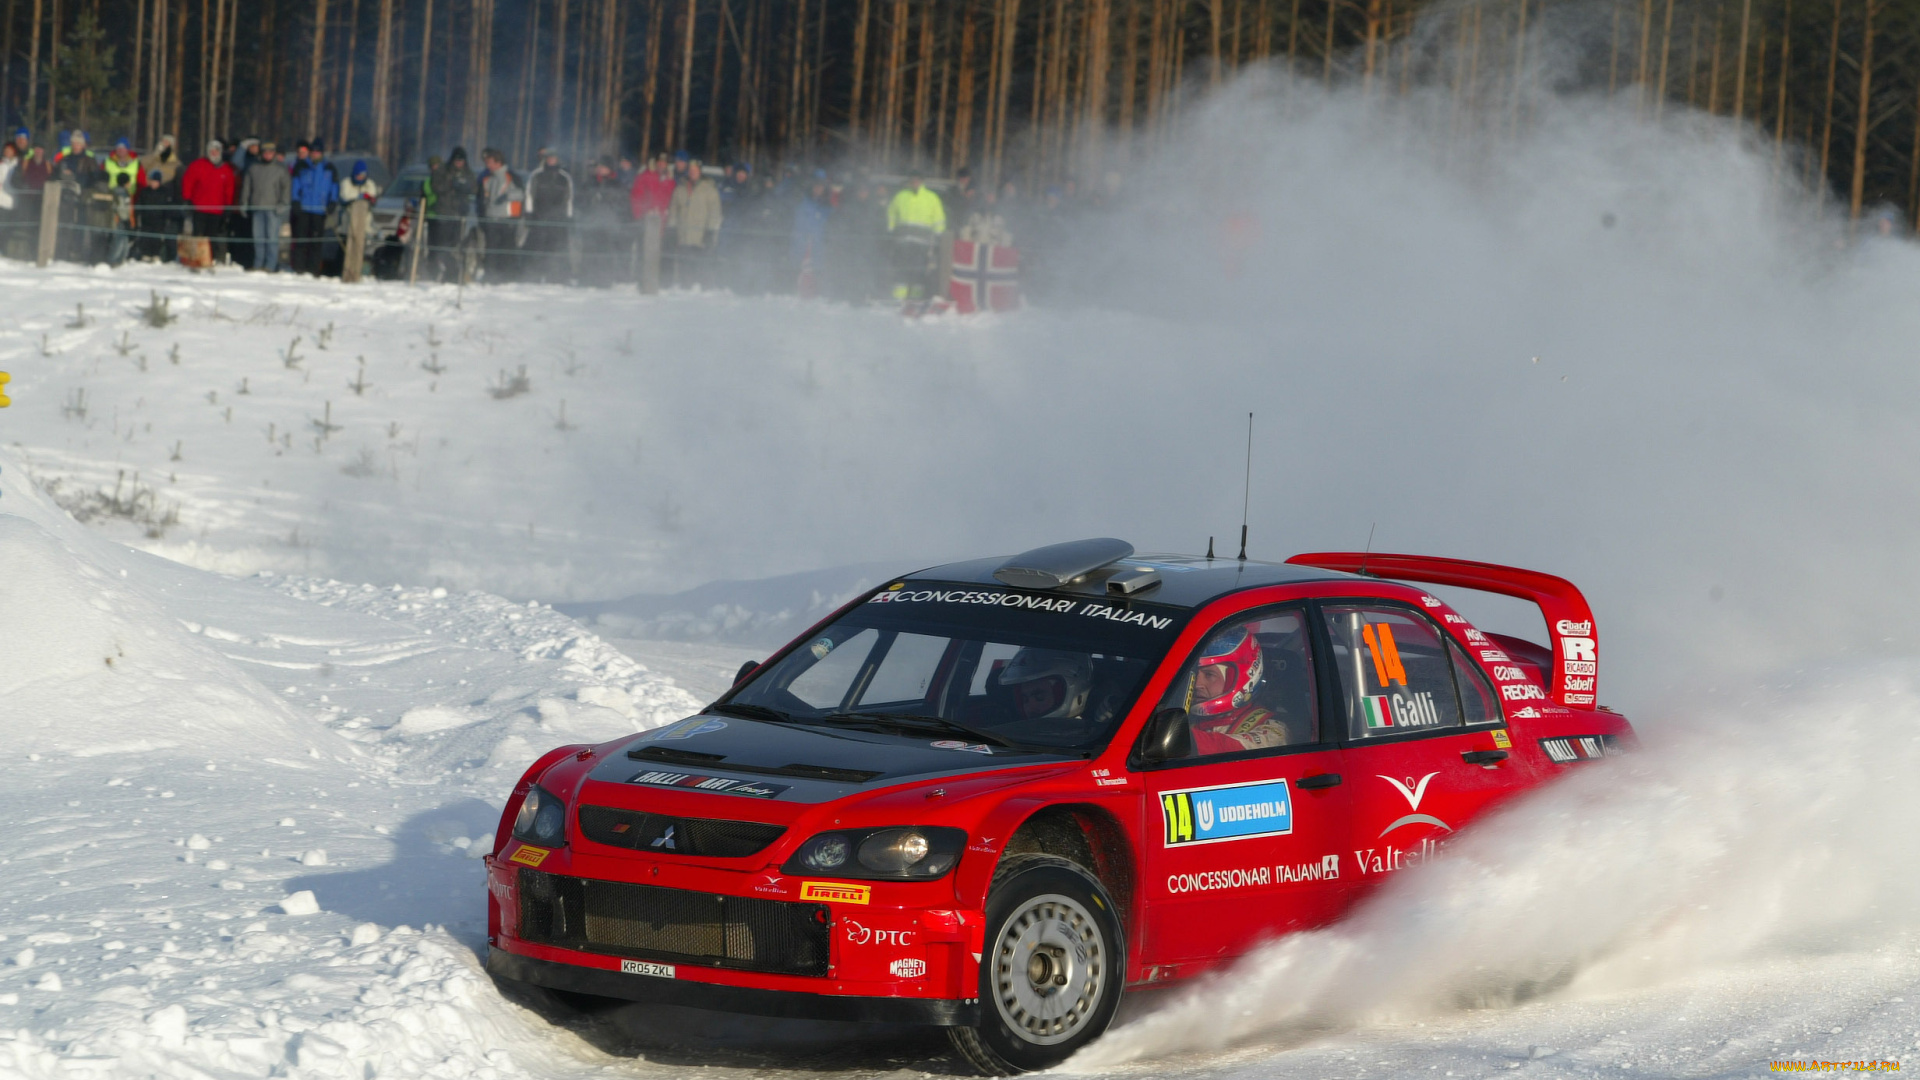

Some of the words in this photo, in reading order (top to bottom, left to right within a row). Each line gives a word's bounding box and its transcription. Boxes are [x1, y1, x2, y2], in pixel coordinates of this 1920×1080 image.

[894, 590, 1076, 614] CONCESSIONARI
[1079, 603, 1173, 630] ITALIANI
[1556, 619, 1592, 636] Eibach
[1363, 623, 1407, 687] 14
[1566, 662, 1595, 674] RICARDO
[1563, 674, 1595, 692] Sabelt
[1502, 685, 1545, 700] RECARO
[1392, 691, 1439, 728] Galli
[1164, 792, 1193, 843] 14
[1218, 800, 1287, 823] UDDEHOLM
[1167, 866, 1271, 894] CONCESSIONARI
[1275, 860, 1322, 884] ITALIANI
[807, 886, 863, 901] PIRELLI
[874, 929, 912, 946] PTC
[623, 961, 650, 974] KR05
[651, 964, 673, 977] ZKL
